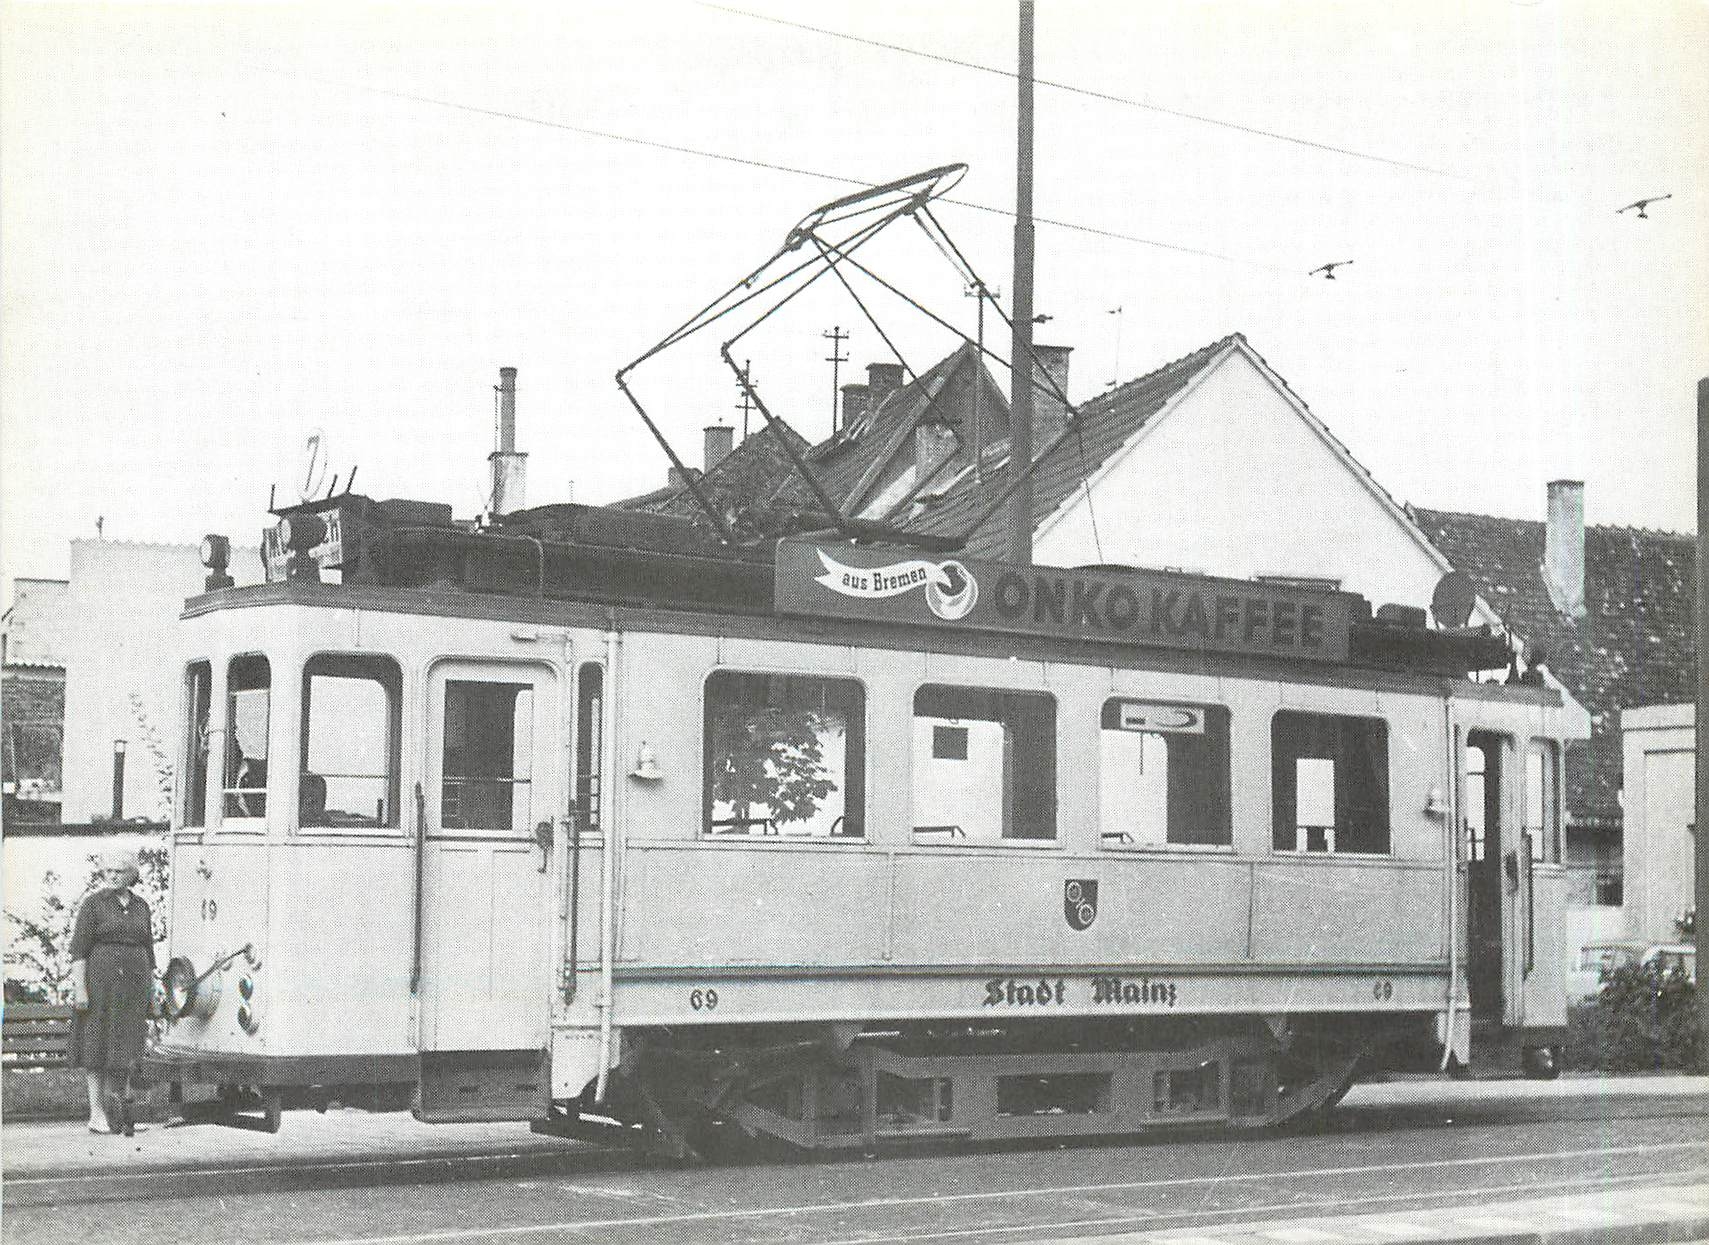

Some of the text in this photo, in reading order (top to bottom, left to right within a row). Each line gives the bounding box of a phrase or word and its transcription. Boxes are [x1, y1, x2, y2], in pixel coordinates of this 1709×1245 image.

[841, 567, 927, 591] aus Bremen
[994, 571, 1324, 648] ONKO KAFFEE
[690, 988, 719, 1011] 69
[982, 976, 1176, 1008] Stadt Mainz
